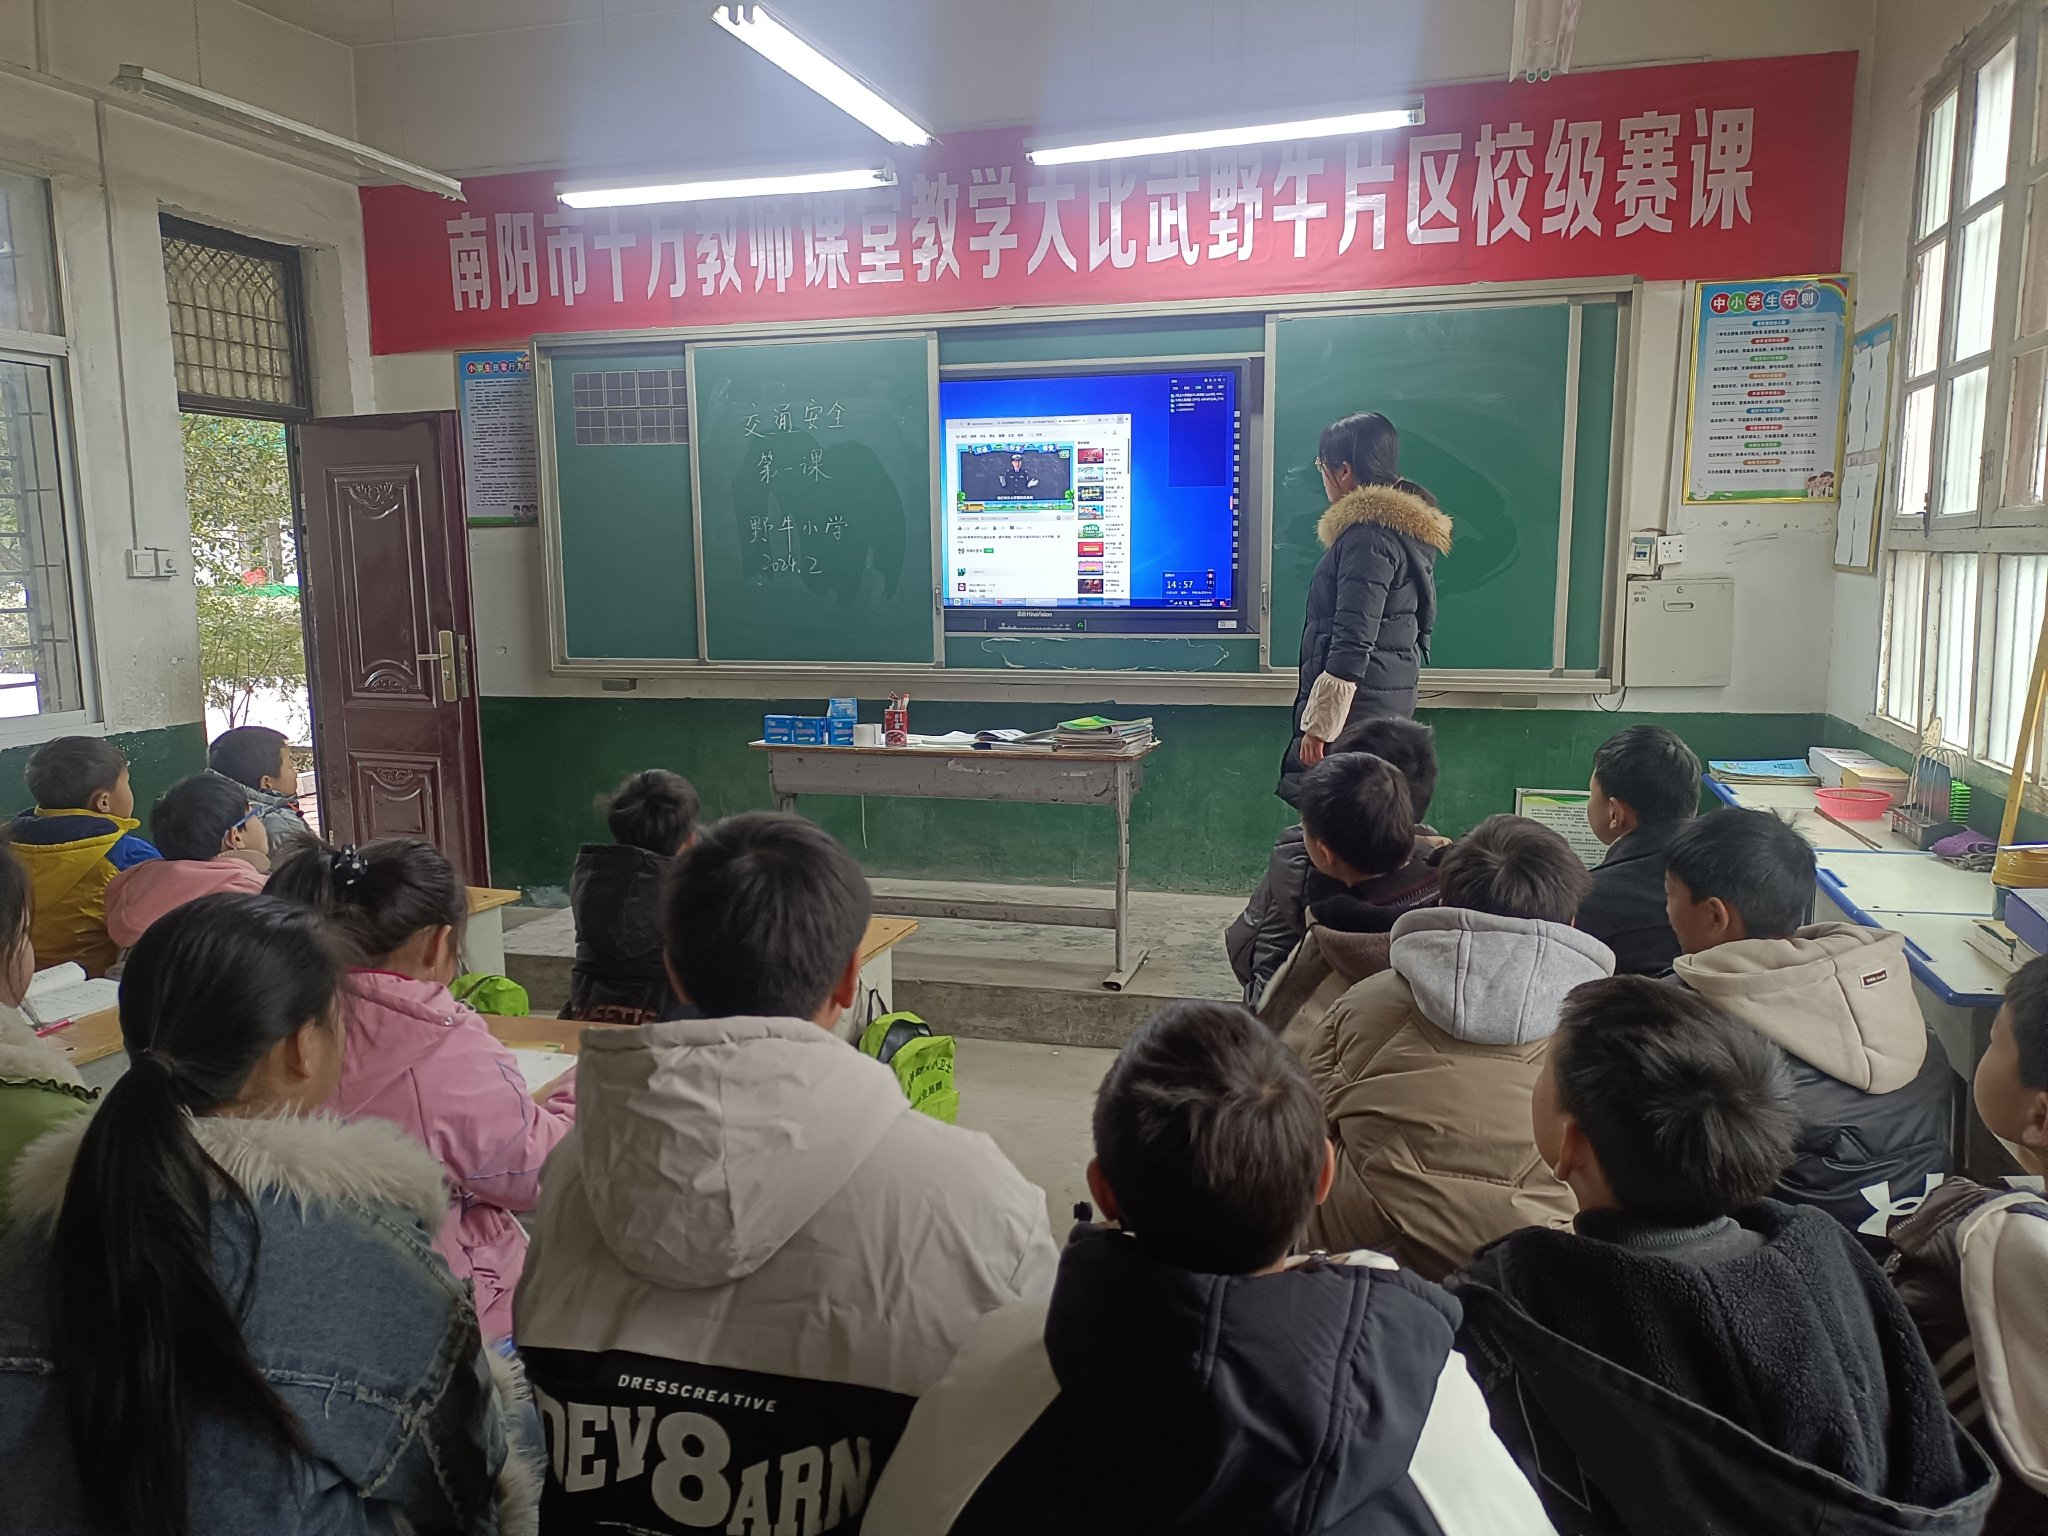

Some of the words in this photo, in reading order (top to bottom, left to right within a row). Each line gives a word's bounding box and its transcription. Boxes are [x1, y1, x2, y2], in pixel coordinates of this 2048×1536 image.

[1712, 288, 1816, 312] 中小学生守则
[744, 398, 846, 438] 交通安全
[757, 449, 832, 484] 第一课
[749, 515, 849, 553] 野牛小学
[617, 1373, 777, 1414] DRESSCREATIVE
